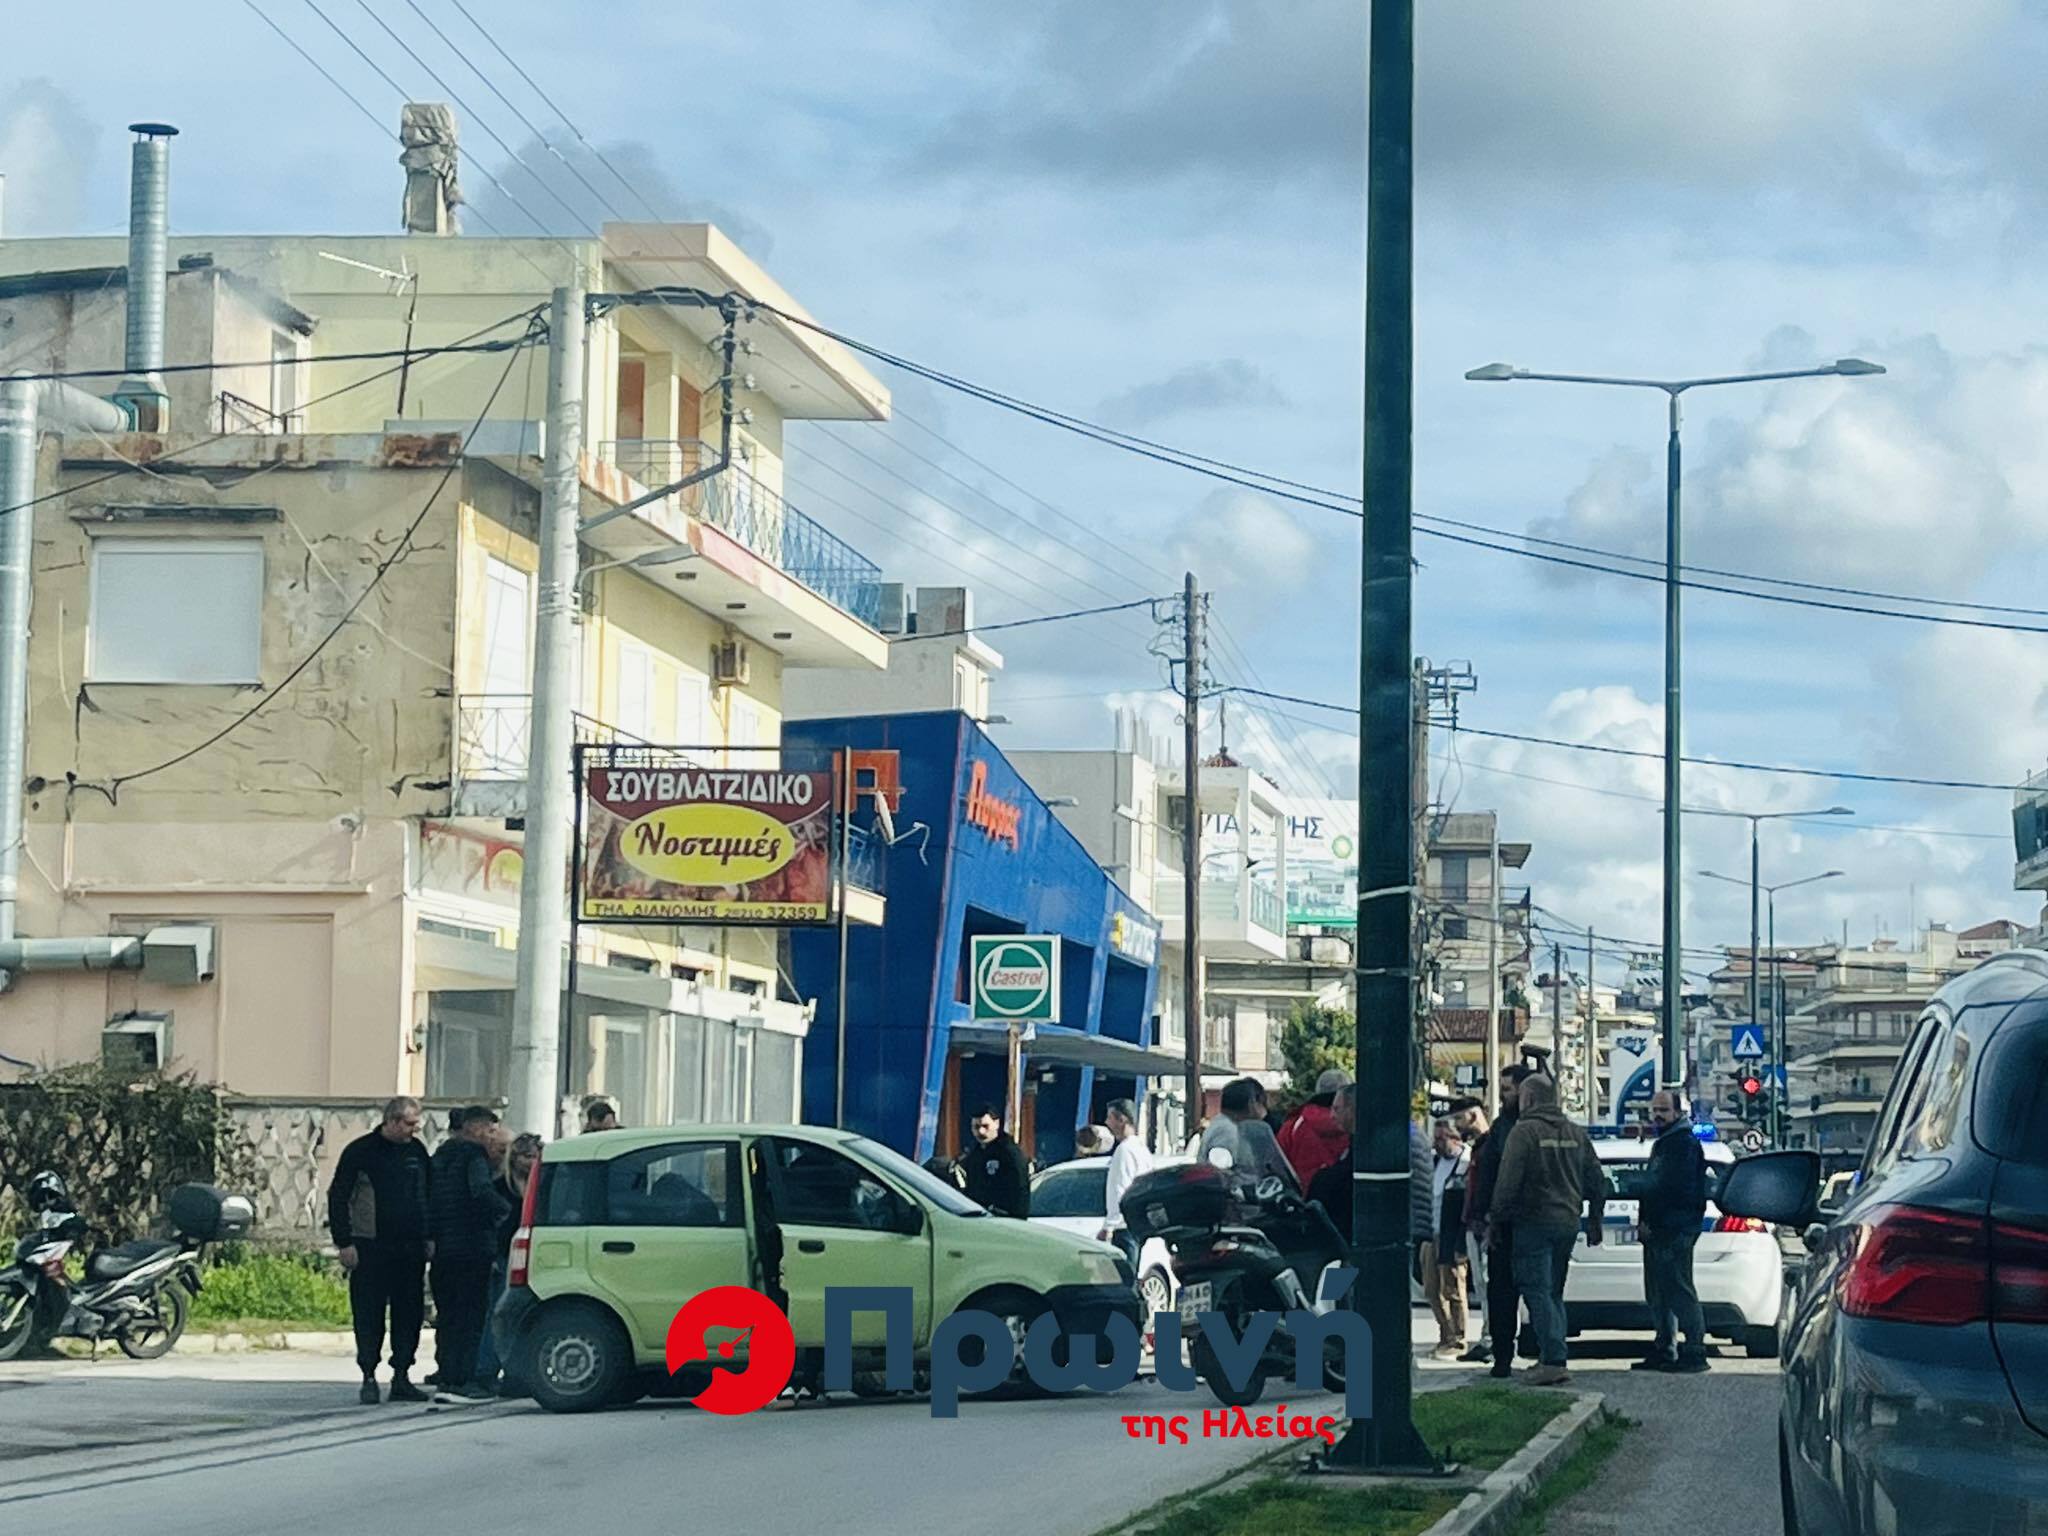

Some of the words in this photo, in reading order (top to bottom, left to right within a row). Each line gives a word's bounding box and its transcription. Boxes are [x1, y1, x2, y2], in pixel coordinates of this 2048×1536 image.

[605, 771, 813, 806] ΣΟΥΒΛΑΤΖΙΔΙΚΟ
[633, 904, 716, 919] ΔΙΑΝΟΜΗΣ
[990, 969, 1044, 986] Castrol
[1608, 1203, 1637, 1211] POL
